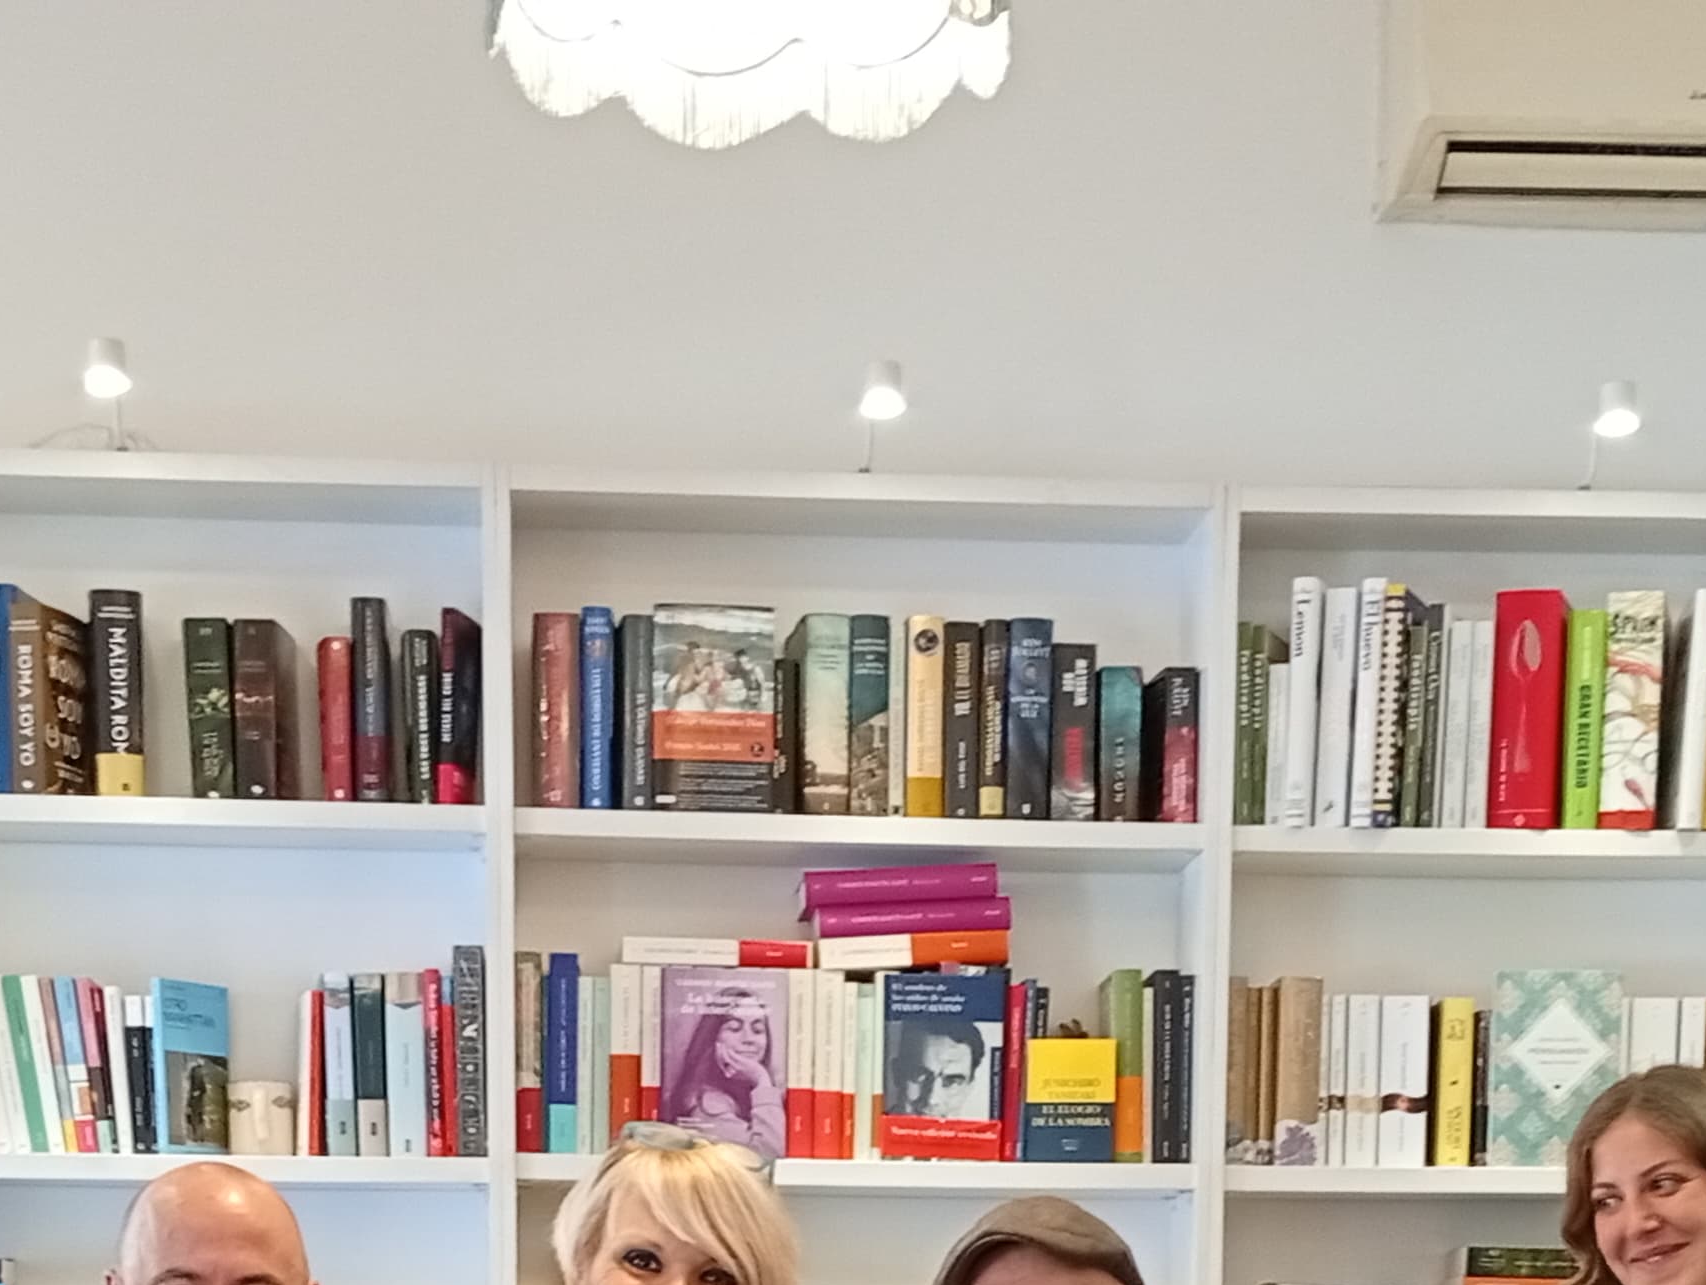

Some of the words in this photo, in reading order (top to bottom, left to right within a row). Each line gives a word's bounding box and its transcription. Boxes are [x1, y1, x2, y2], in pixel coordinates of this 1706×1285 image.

[1294, 599, 1312, 658] Lemon
[16, 645, 37, 698] ROMA
[107, 627, 129, 711] MALDITA
[19, 704, 38, 737] SOY
[20, 740, 39, 767] YO
